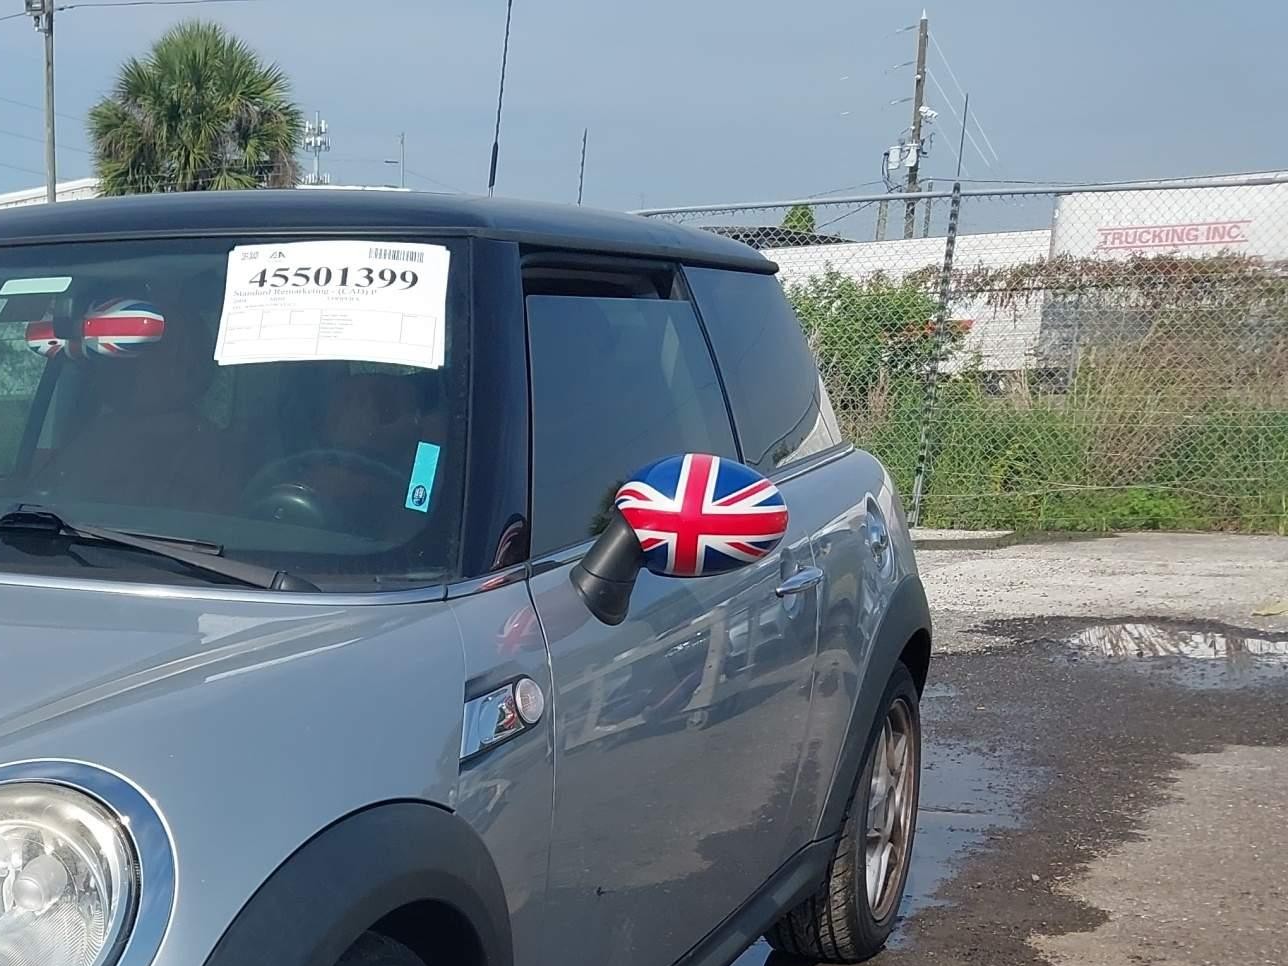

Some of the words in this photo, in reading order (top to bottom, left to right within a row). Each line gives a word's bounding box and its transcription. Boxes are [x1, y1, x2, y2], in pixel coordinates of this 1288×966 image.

[1100, 227, 1199, 246] TRUCKING
[1206, 224, 1245, 241] INC.
[248, 266, 419, 290] 45501399
